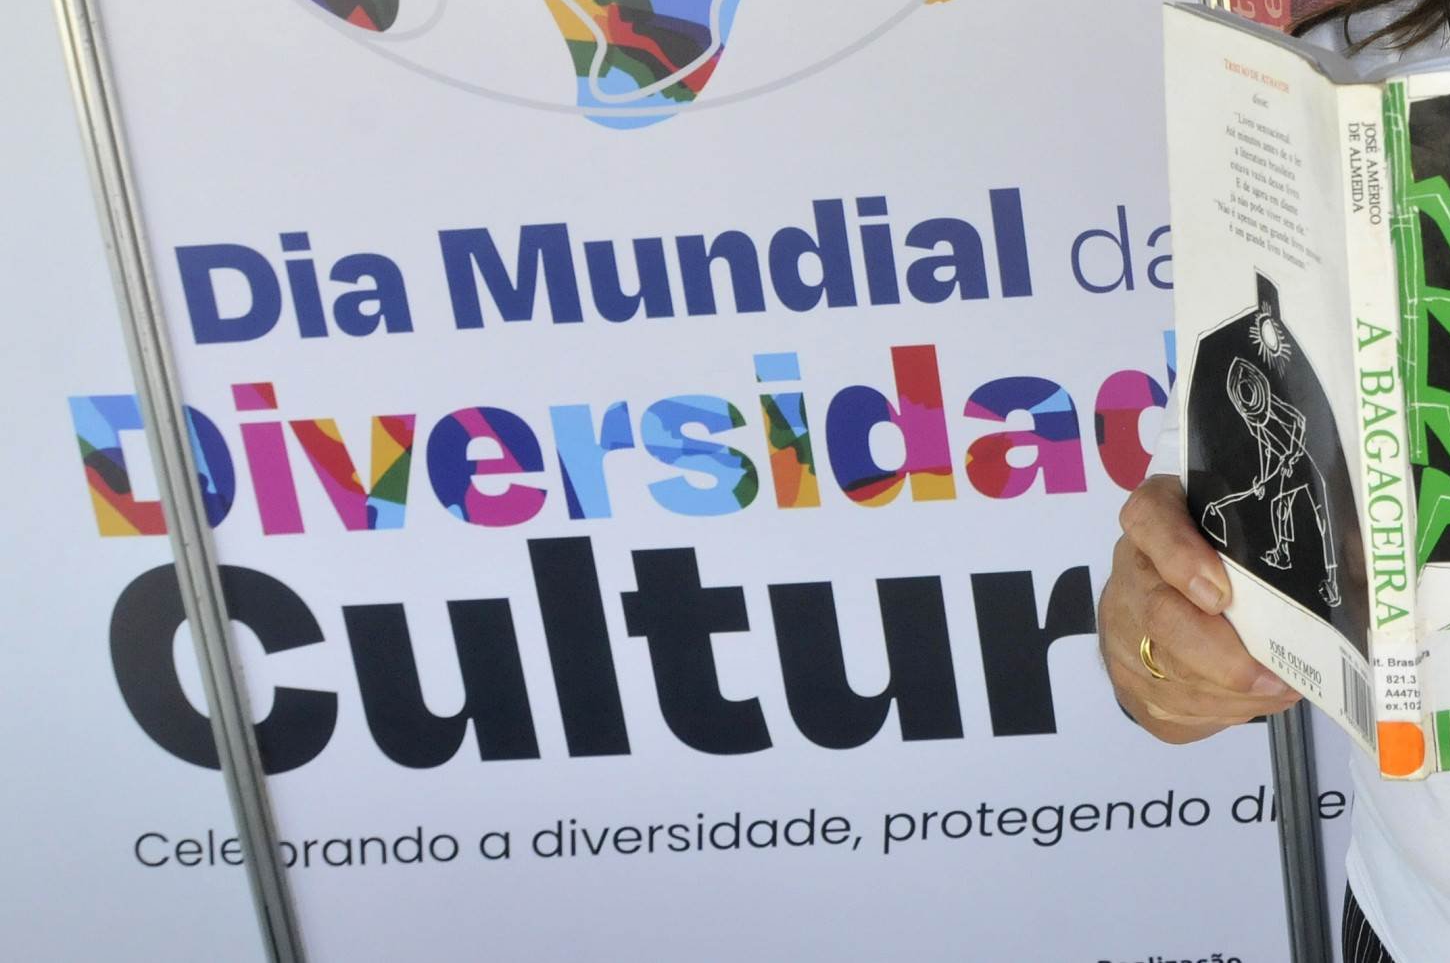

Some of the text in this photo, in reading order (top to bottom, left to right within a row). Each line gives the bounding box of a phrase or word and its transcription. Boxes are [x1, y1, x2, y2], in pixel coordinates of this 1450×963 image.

[1348, 121, 1365, 215] DE ALMEIDA
[1361, 121, 1384, 226] JOSÉ AMÉRICO
[175, 231, 414, 345] Dia
[438, 187, 1033, 330] Mundial
[68, 330, 1177, 537] Diversidad
[1356, 317, 1411, 630] A BAGACEIRA
[1268, 639, 1287, 660] JOSÉ
[1286, 651, 1323, 685] OLYMPIO
[1384, 689, 1422, 699] A447b
[1385, 675, 1417, 685] 821.3
[479, 826, 512, 862] a
[531, 807, 863, 859] diversidade,
[883, 789, 1212, 854] protegendo
